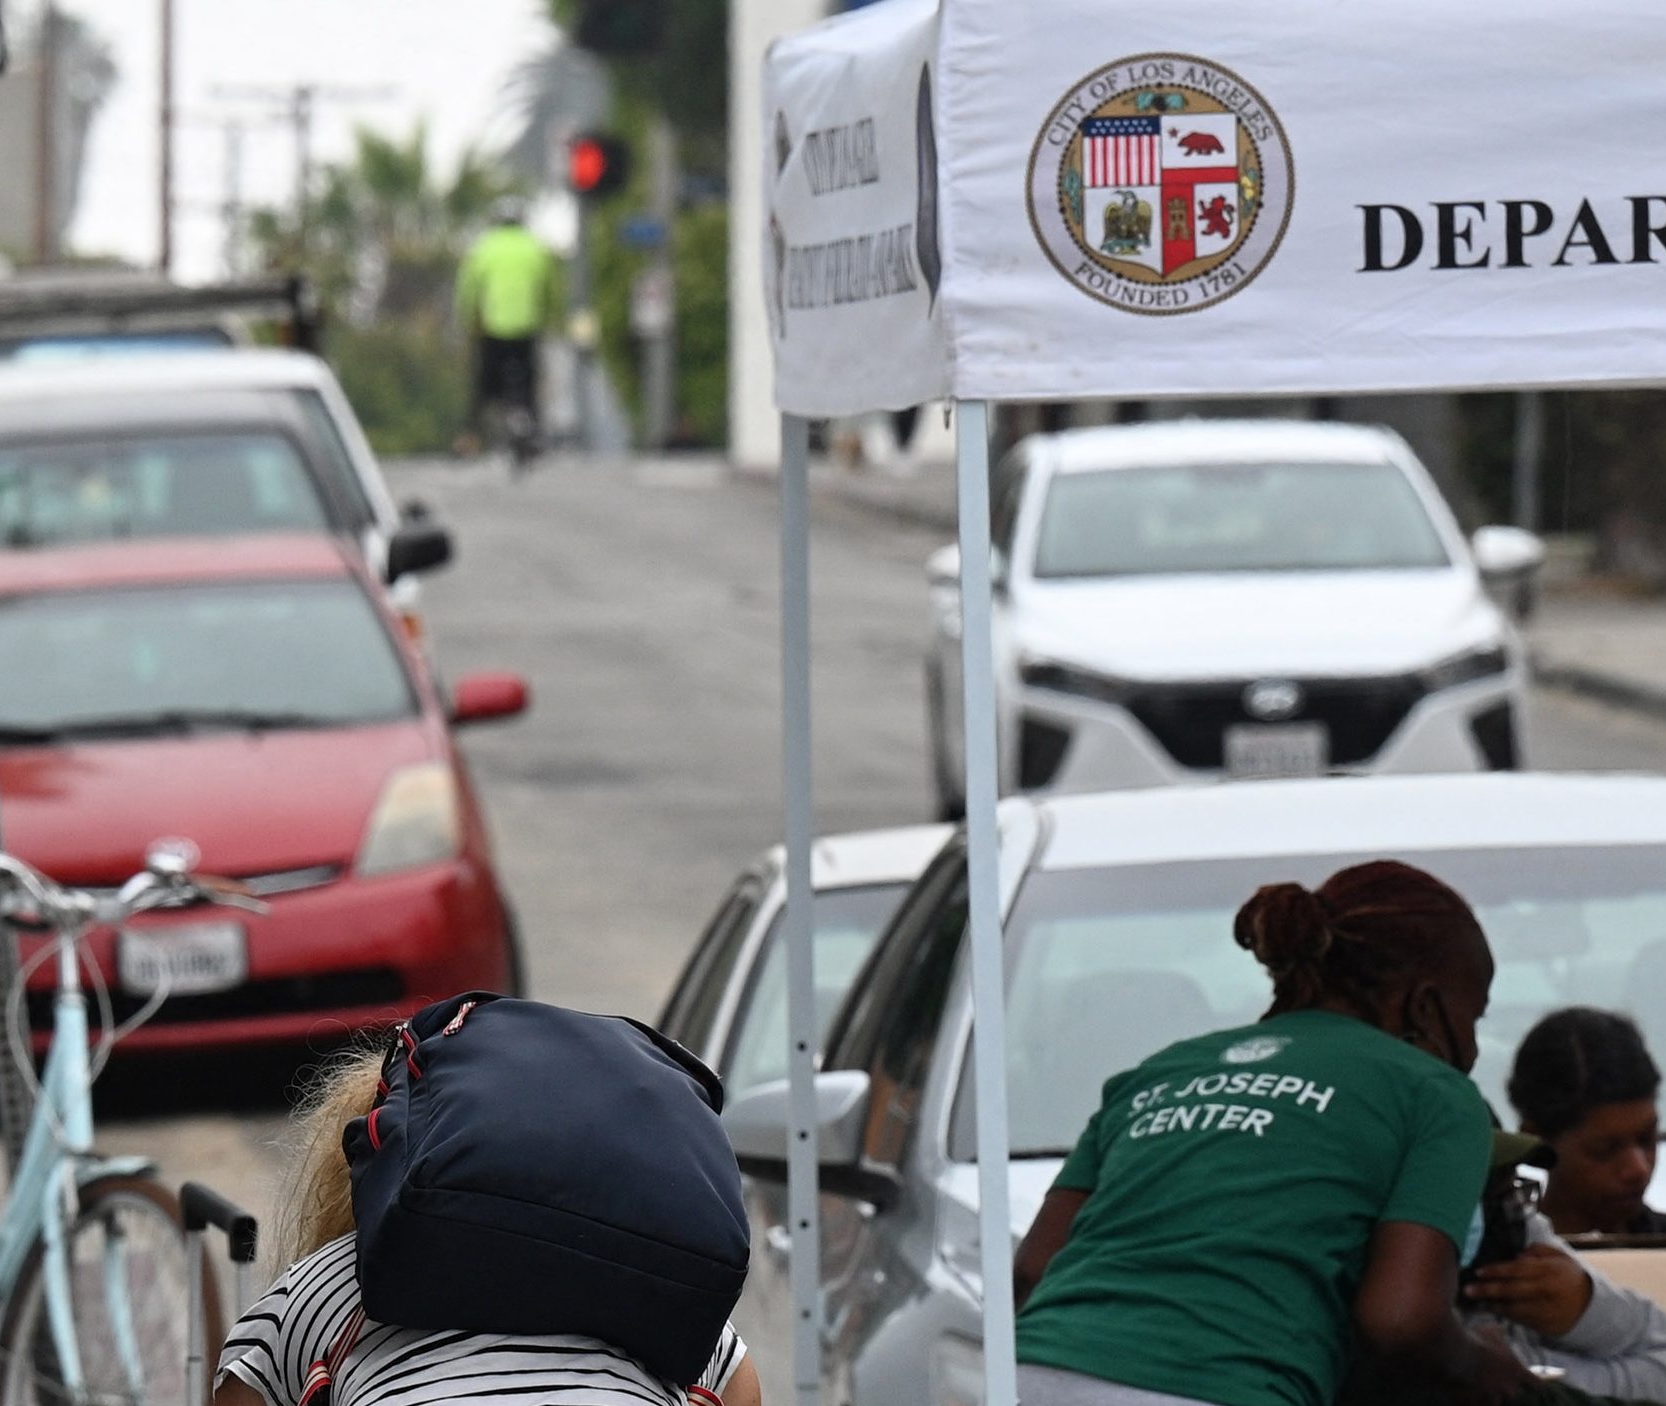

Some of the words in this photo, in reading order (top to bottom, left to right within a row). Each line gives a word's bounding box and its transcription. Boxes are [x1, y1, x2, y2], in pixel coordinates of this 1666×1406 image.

[1047, 99, 1088, 147] CITY
[1089, 73, 1120, 100] OF
[1128, 62, 1175, 83] LOS
[1182, 65, 1274, 143] ANGELES
[1073, 260, 1189, 306] FOUNDED
[1199, 261, 1247, 299] 1781
[1174, 1072, 1335, 1113] JOSEPH
[1129, 1103, 1274, 1138] CENTER
